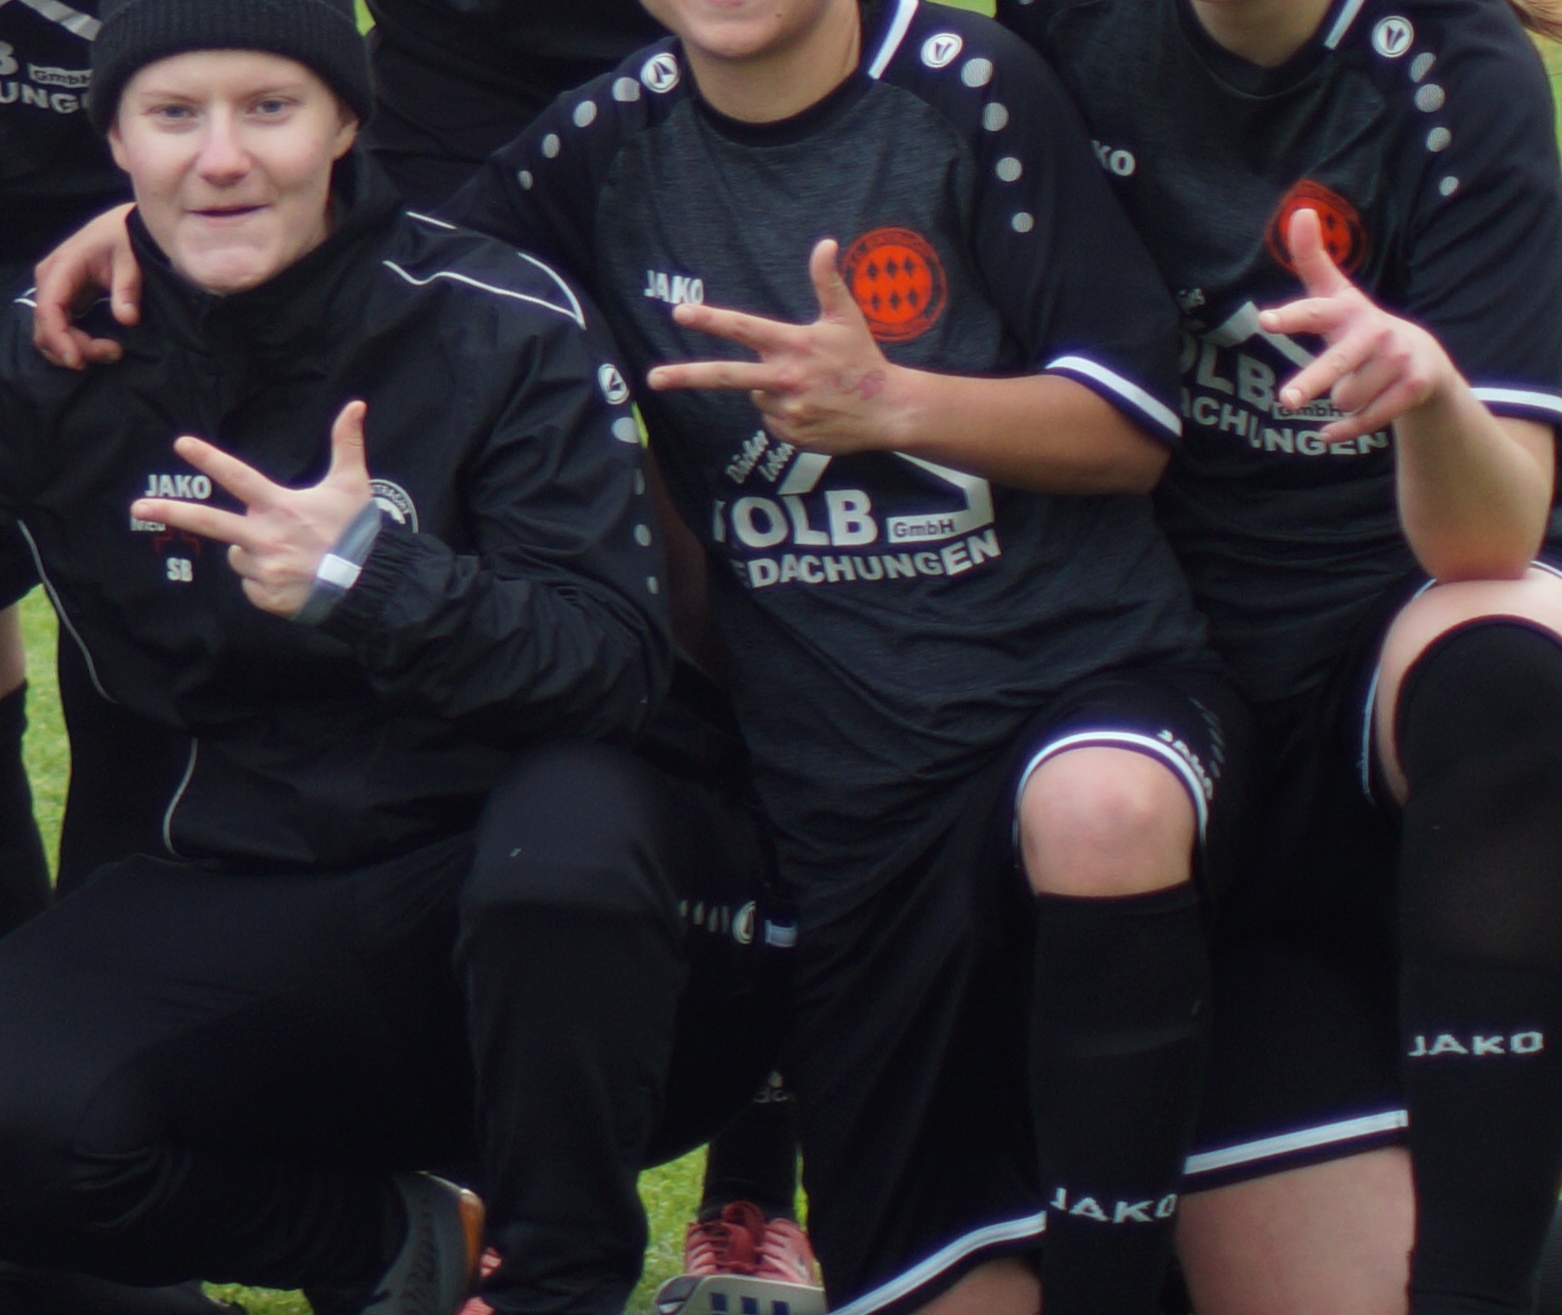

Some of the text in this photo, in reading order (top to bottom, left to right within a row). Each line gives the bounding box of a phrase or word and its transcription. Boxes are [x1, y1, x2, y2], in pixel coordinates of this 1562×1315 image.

[1090, 139, 1136, 177] KO
[644, 269, 705, 306] JAKO
[145, 474, 212, 500] JAKO
[892, 518, 957, 538] GmbH
[166, 557, 194, 583] SB
[1408, 1031, 1544, 1056] JAKO
[1050, 1187, 1177, 1223] JAKO
